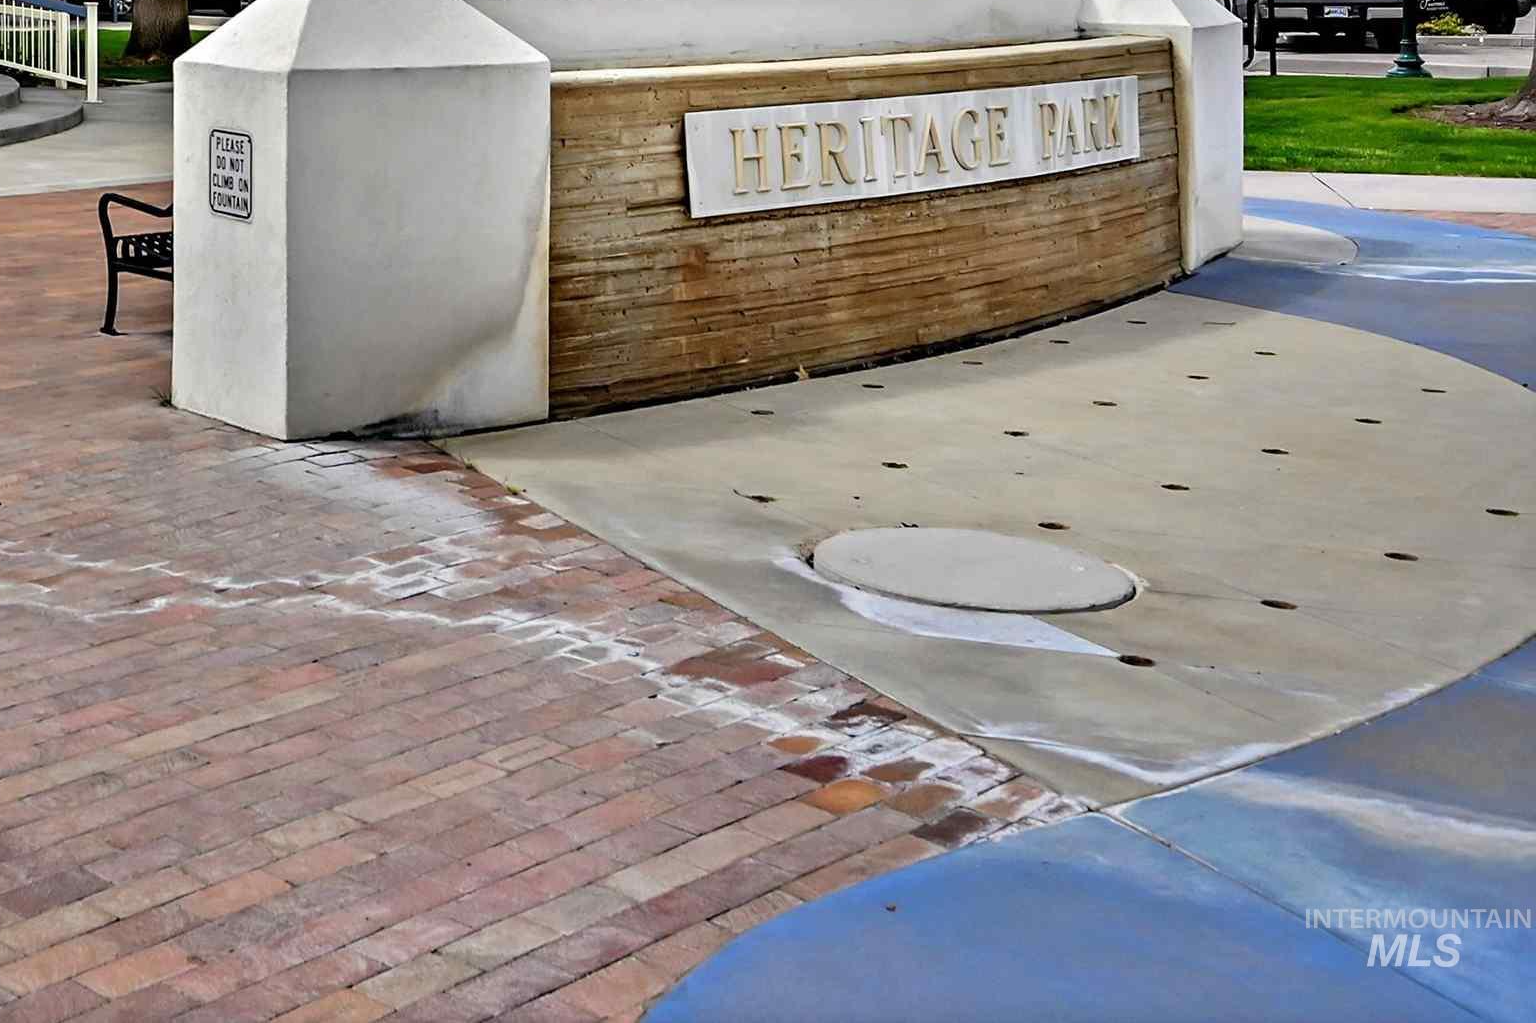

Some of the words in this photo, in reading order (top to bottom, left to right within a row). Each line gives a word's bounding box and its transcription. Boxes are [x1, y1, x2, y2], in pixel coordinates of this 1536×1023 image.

[215, 136, 245, 155] PLEASE
[729, 105, 1010, 195] HERITAGE
[1038, 88, 1123, 160] PARK
[216, 155, 226, 170] DO
[229, 157, 244, 174] NOT
[212, 173, 234, 190] CLIMB
[238, 177, 249, 193] ON
[212, 191, 249, 213] FOUNTAIN
